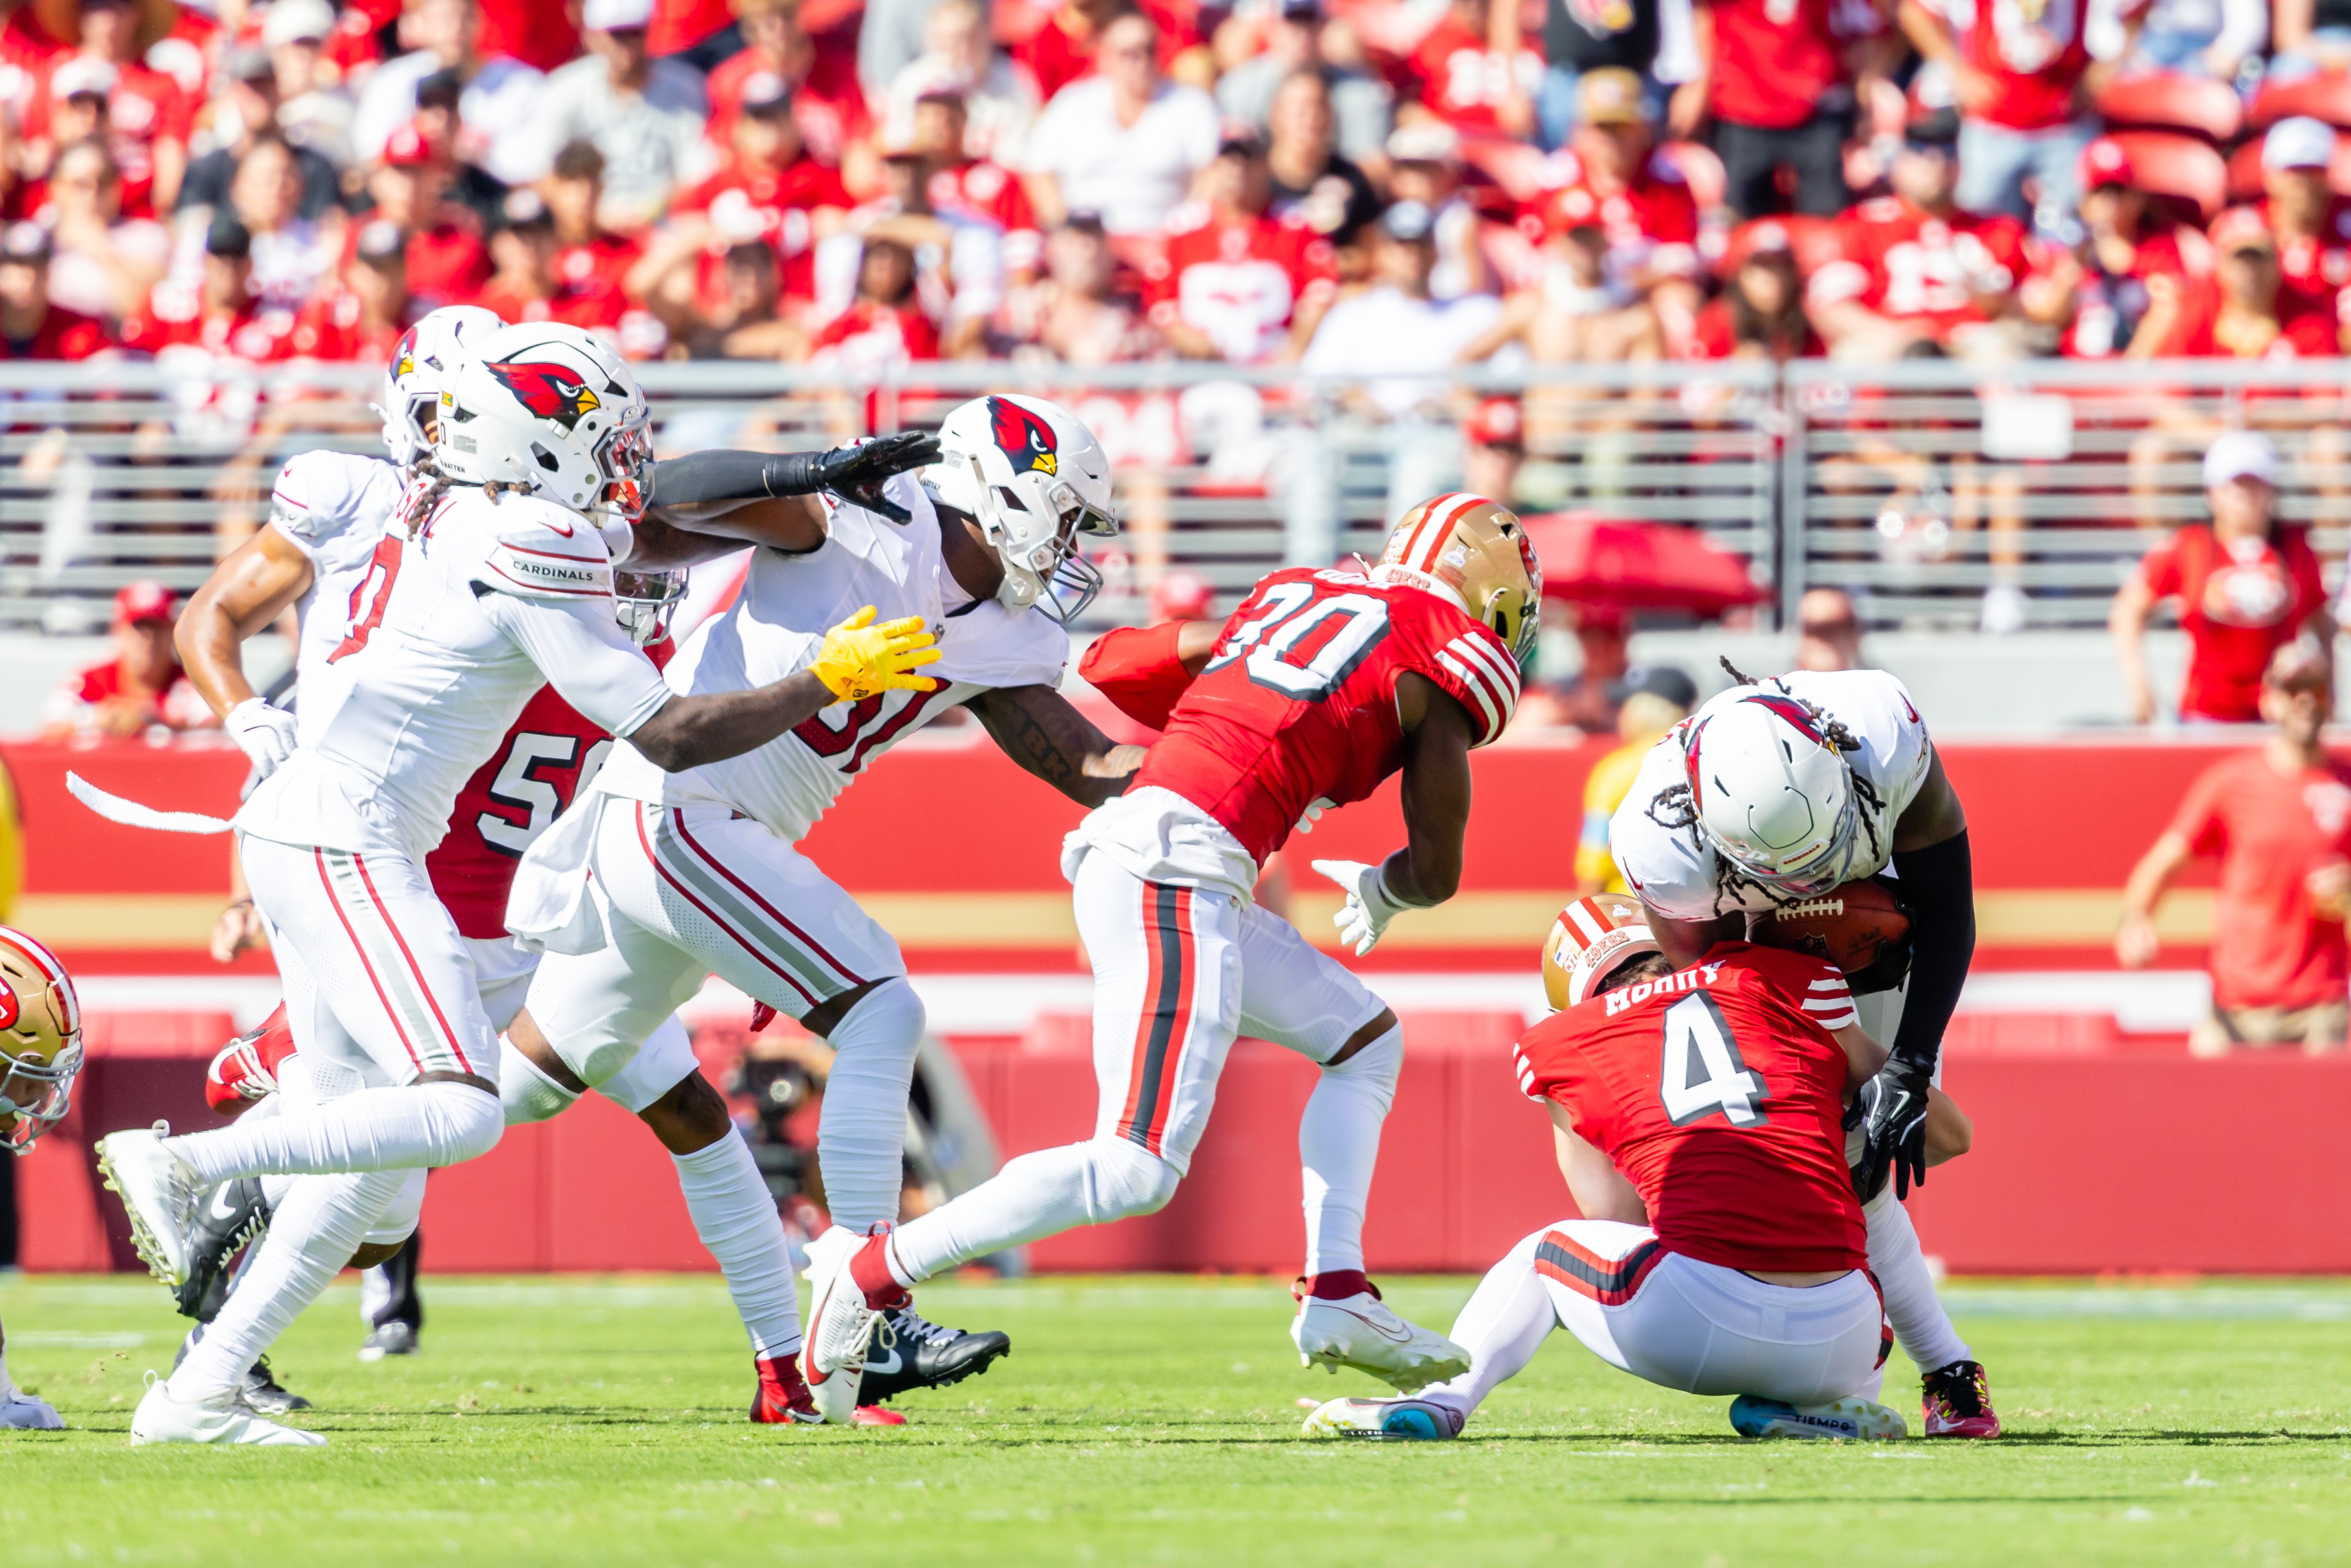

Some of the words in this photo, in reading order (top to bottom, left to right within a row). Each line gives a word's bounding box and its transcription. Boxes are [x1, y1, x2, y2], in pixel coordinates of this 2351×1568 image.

[513, 560, 593, 582] CARDINALS
[1202, 582, 1391, 703] 30
[1783, 844, 1821, 865] CARDINALS
[1584, 930, 1630, 968] 49ERS
[1659, 988, 1772, 1129] 4
[1793, 1414, 1850, 1431] TIEMPO
